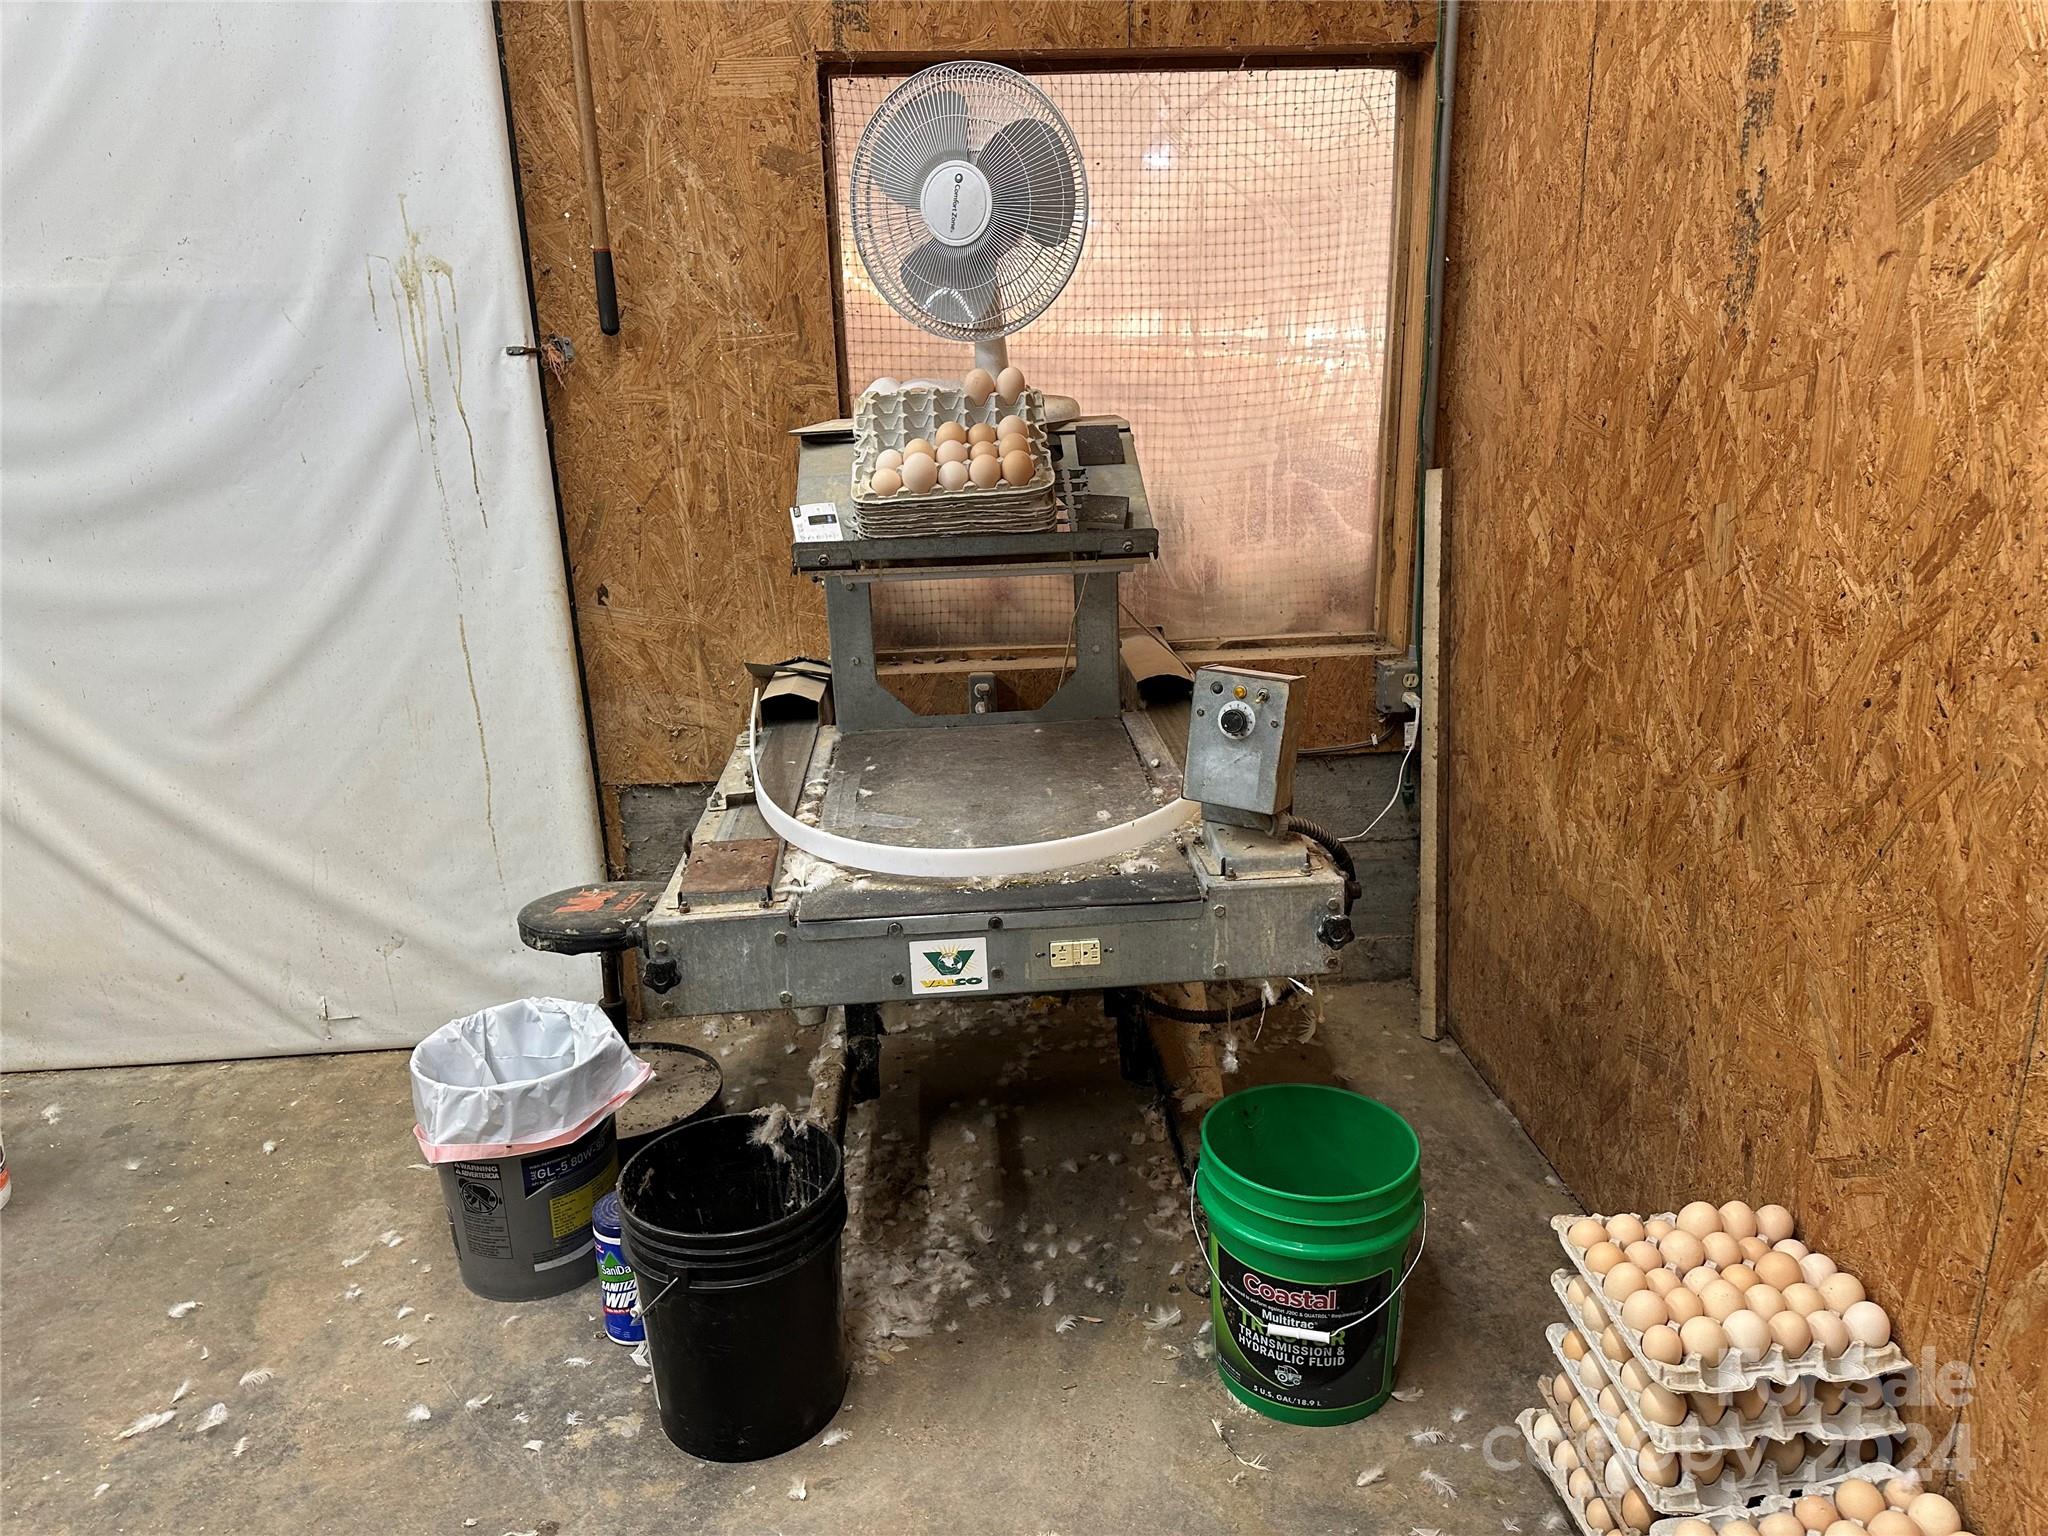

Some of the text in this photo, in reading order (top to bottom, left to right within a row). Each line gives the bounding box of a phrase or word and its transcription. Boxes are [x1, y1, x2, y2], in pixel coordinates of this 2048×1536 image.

[952, 184, 961, 211] Comfort
[920, 977, 982, 988] VALCO
[459, 1162, 498, 1173] WARNING
[537, 1159, 568, 1180] GL-5
[606, 1291, 638, 1309] WIP
[1243, 1273, 1337, 1310] Coastal
[1261, 1308, 1315, 1330] Multitrac
[1238, 1323, 1332, 1357] TRANSMISSION
[1336, 1346, 1345, 1356] &
[1238, 1333, 1345, 1367] HYDRAULIC FLUID
